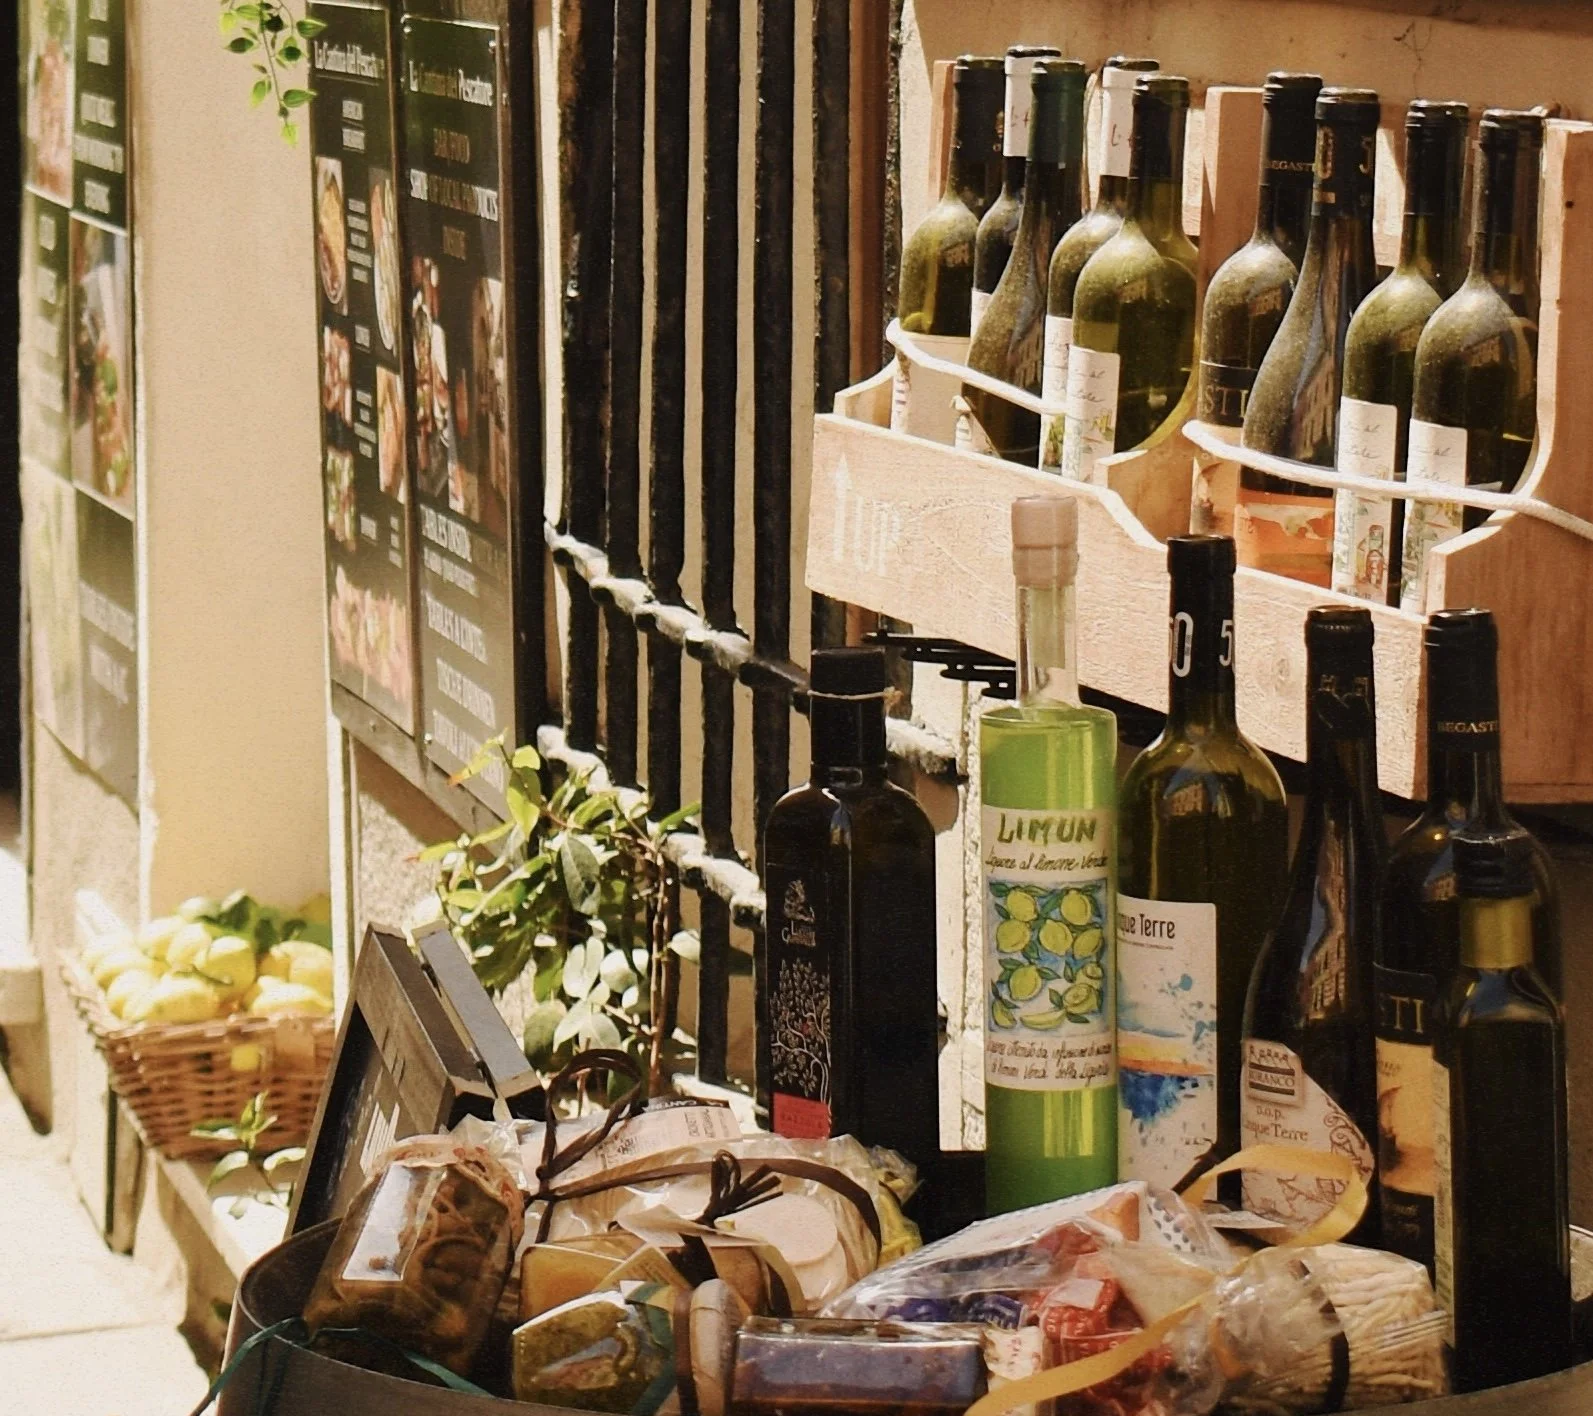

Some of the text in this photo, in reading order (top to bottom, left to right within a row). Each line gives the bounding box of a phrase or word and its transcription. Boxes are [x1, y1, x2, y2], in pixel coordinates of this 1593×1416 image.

[997, 812, 1097, 846] LIMUN
[1139, 913, 1176, 939] Terre
[1271, 1123, 1309, 1141] Terre
